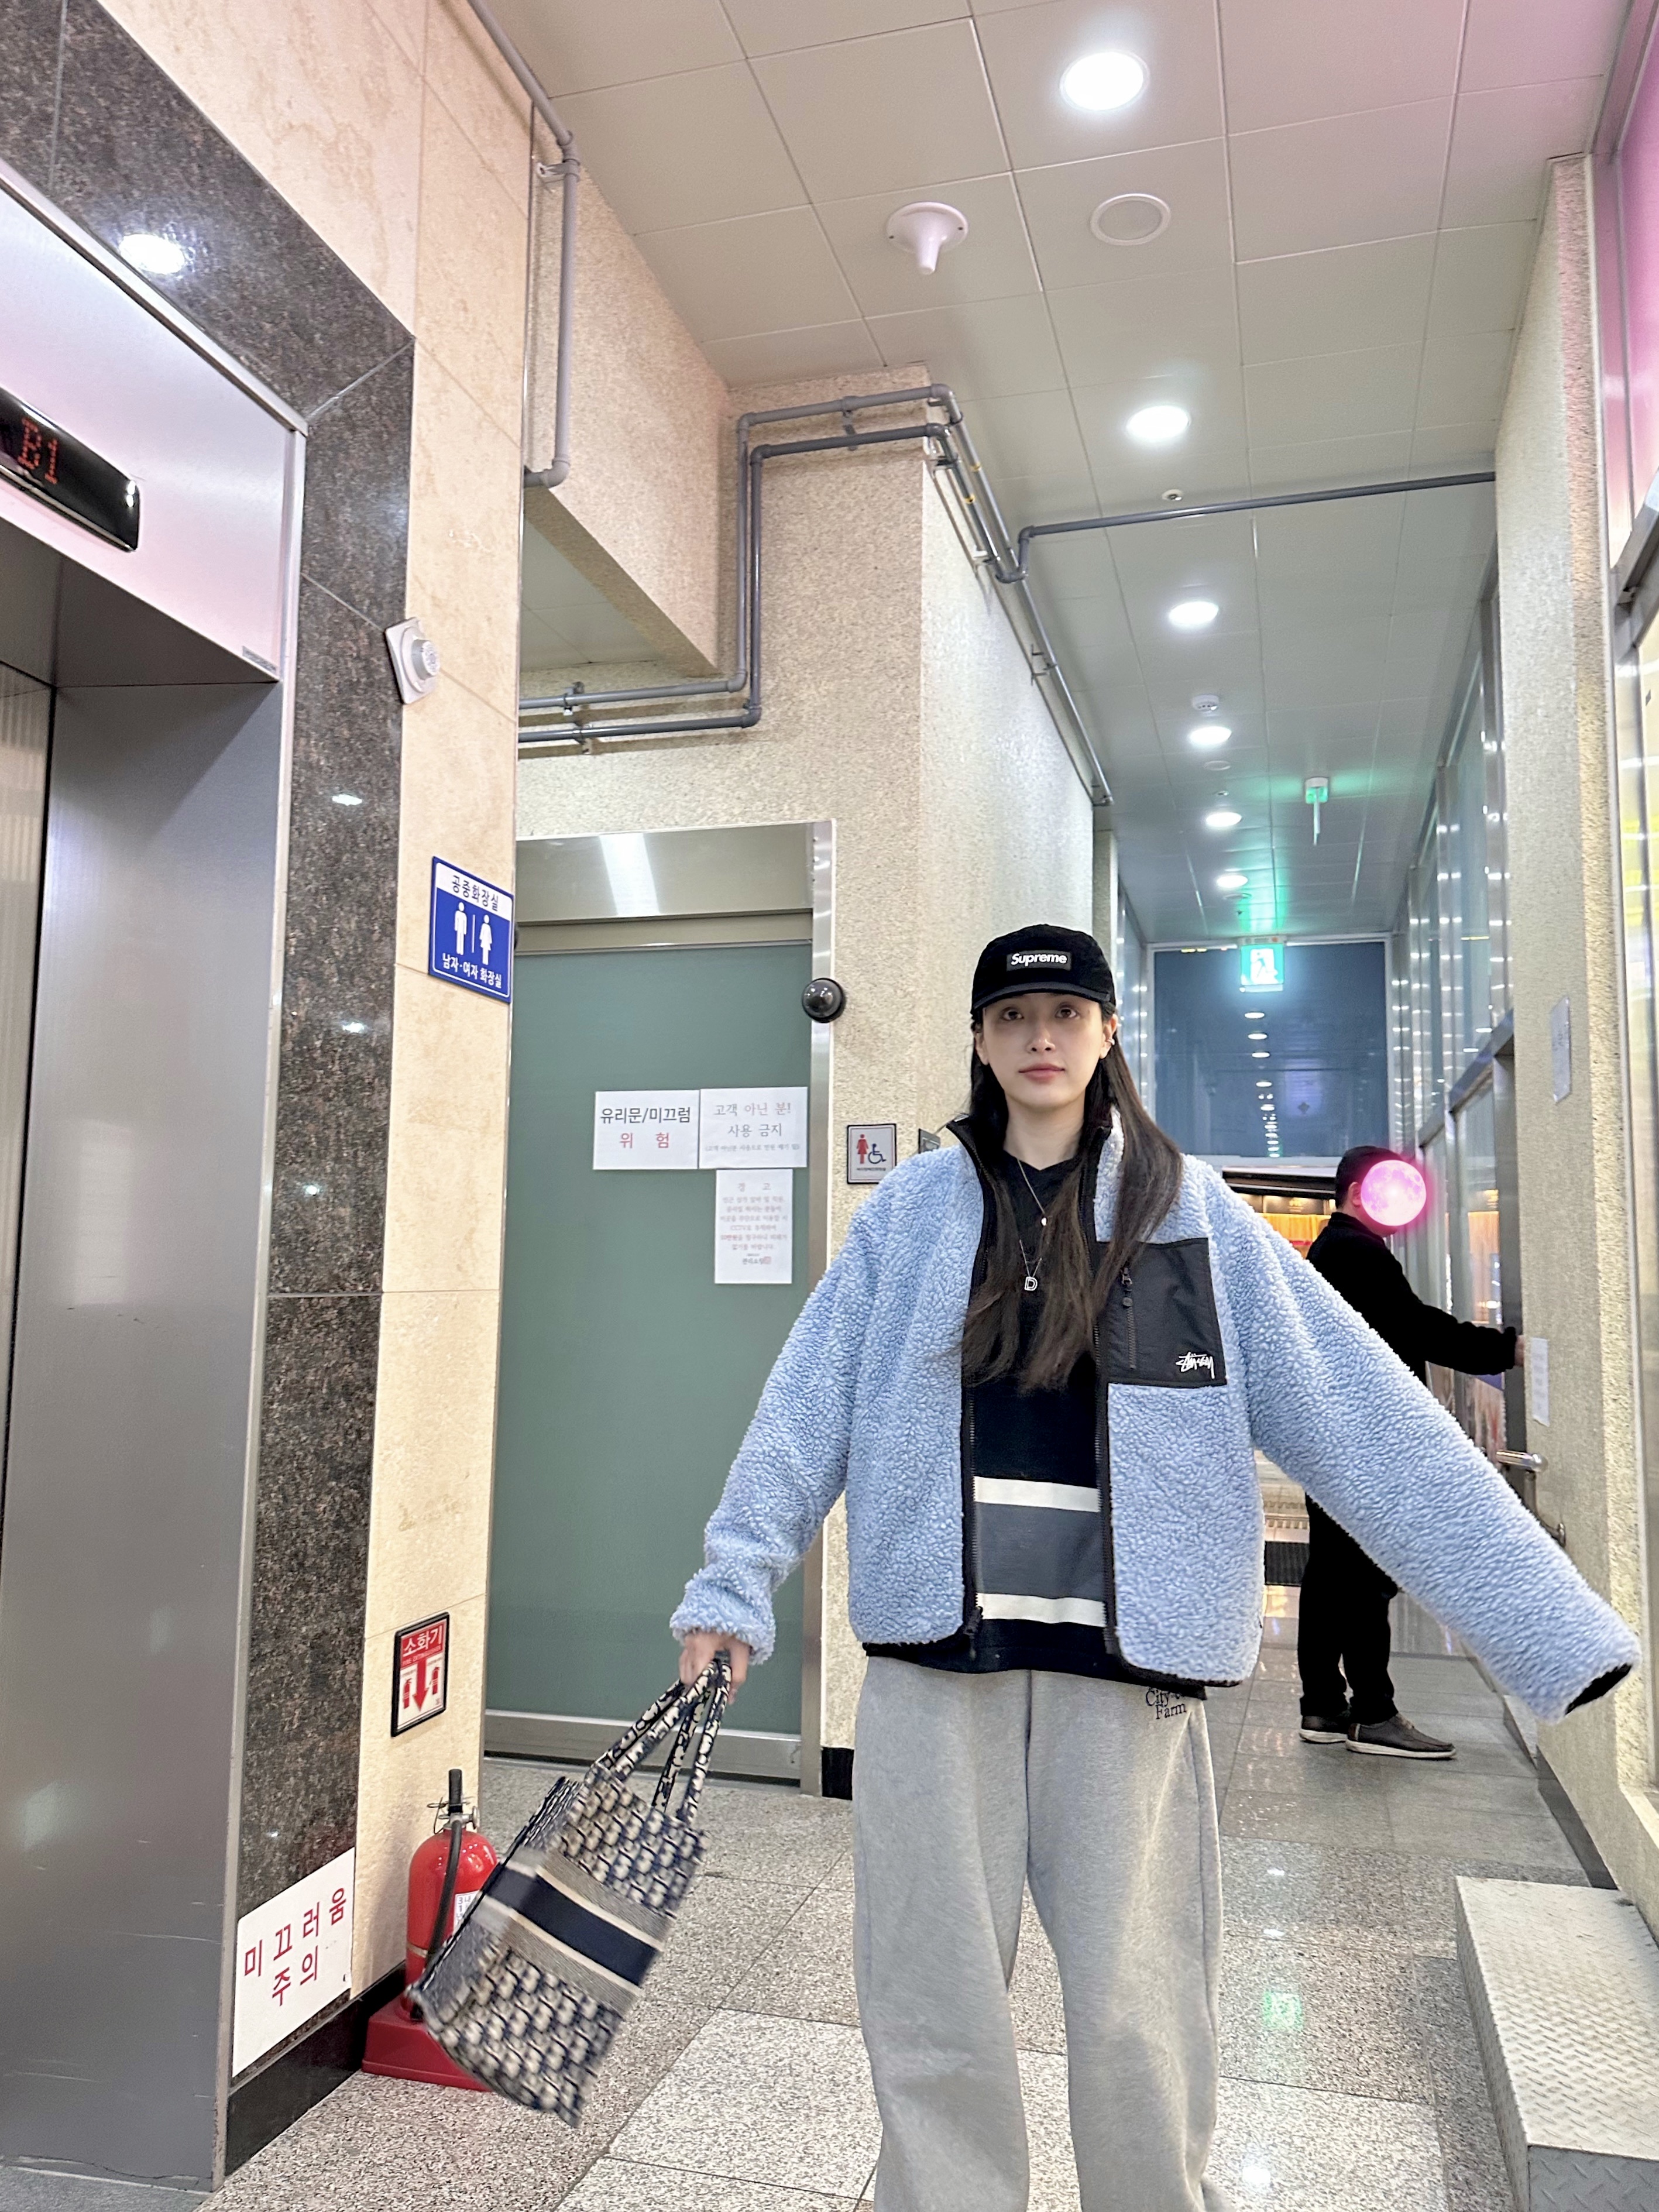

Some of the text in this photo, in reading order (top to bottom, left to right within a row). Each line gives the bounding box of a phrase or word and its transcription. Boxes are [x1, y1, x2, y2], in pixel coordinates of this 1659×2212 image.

[17, 416, 58, 484] B1
[452, 875, 499, 912] 공중화장실
[1011, 953, 1067, 967] Supreme
[480, 967, 502, 989] 화장실
[600, 1107, 692, 1124] 유리문/미끄럼
[713, 1102, 792, 1117] 고객 아닌 분!
[727, 1122, 783, 1138] 사용 금지
[1024, 1276, 1038, 1292] D
[402, 1624, 443, 1657] 소화기
[1155, 1703, 1187, 1719] Farm
